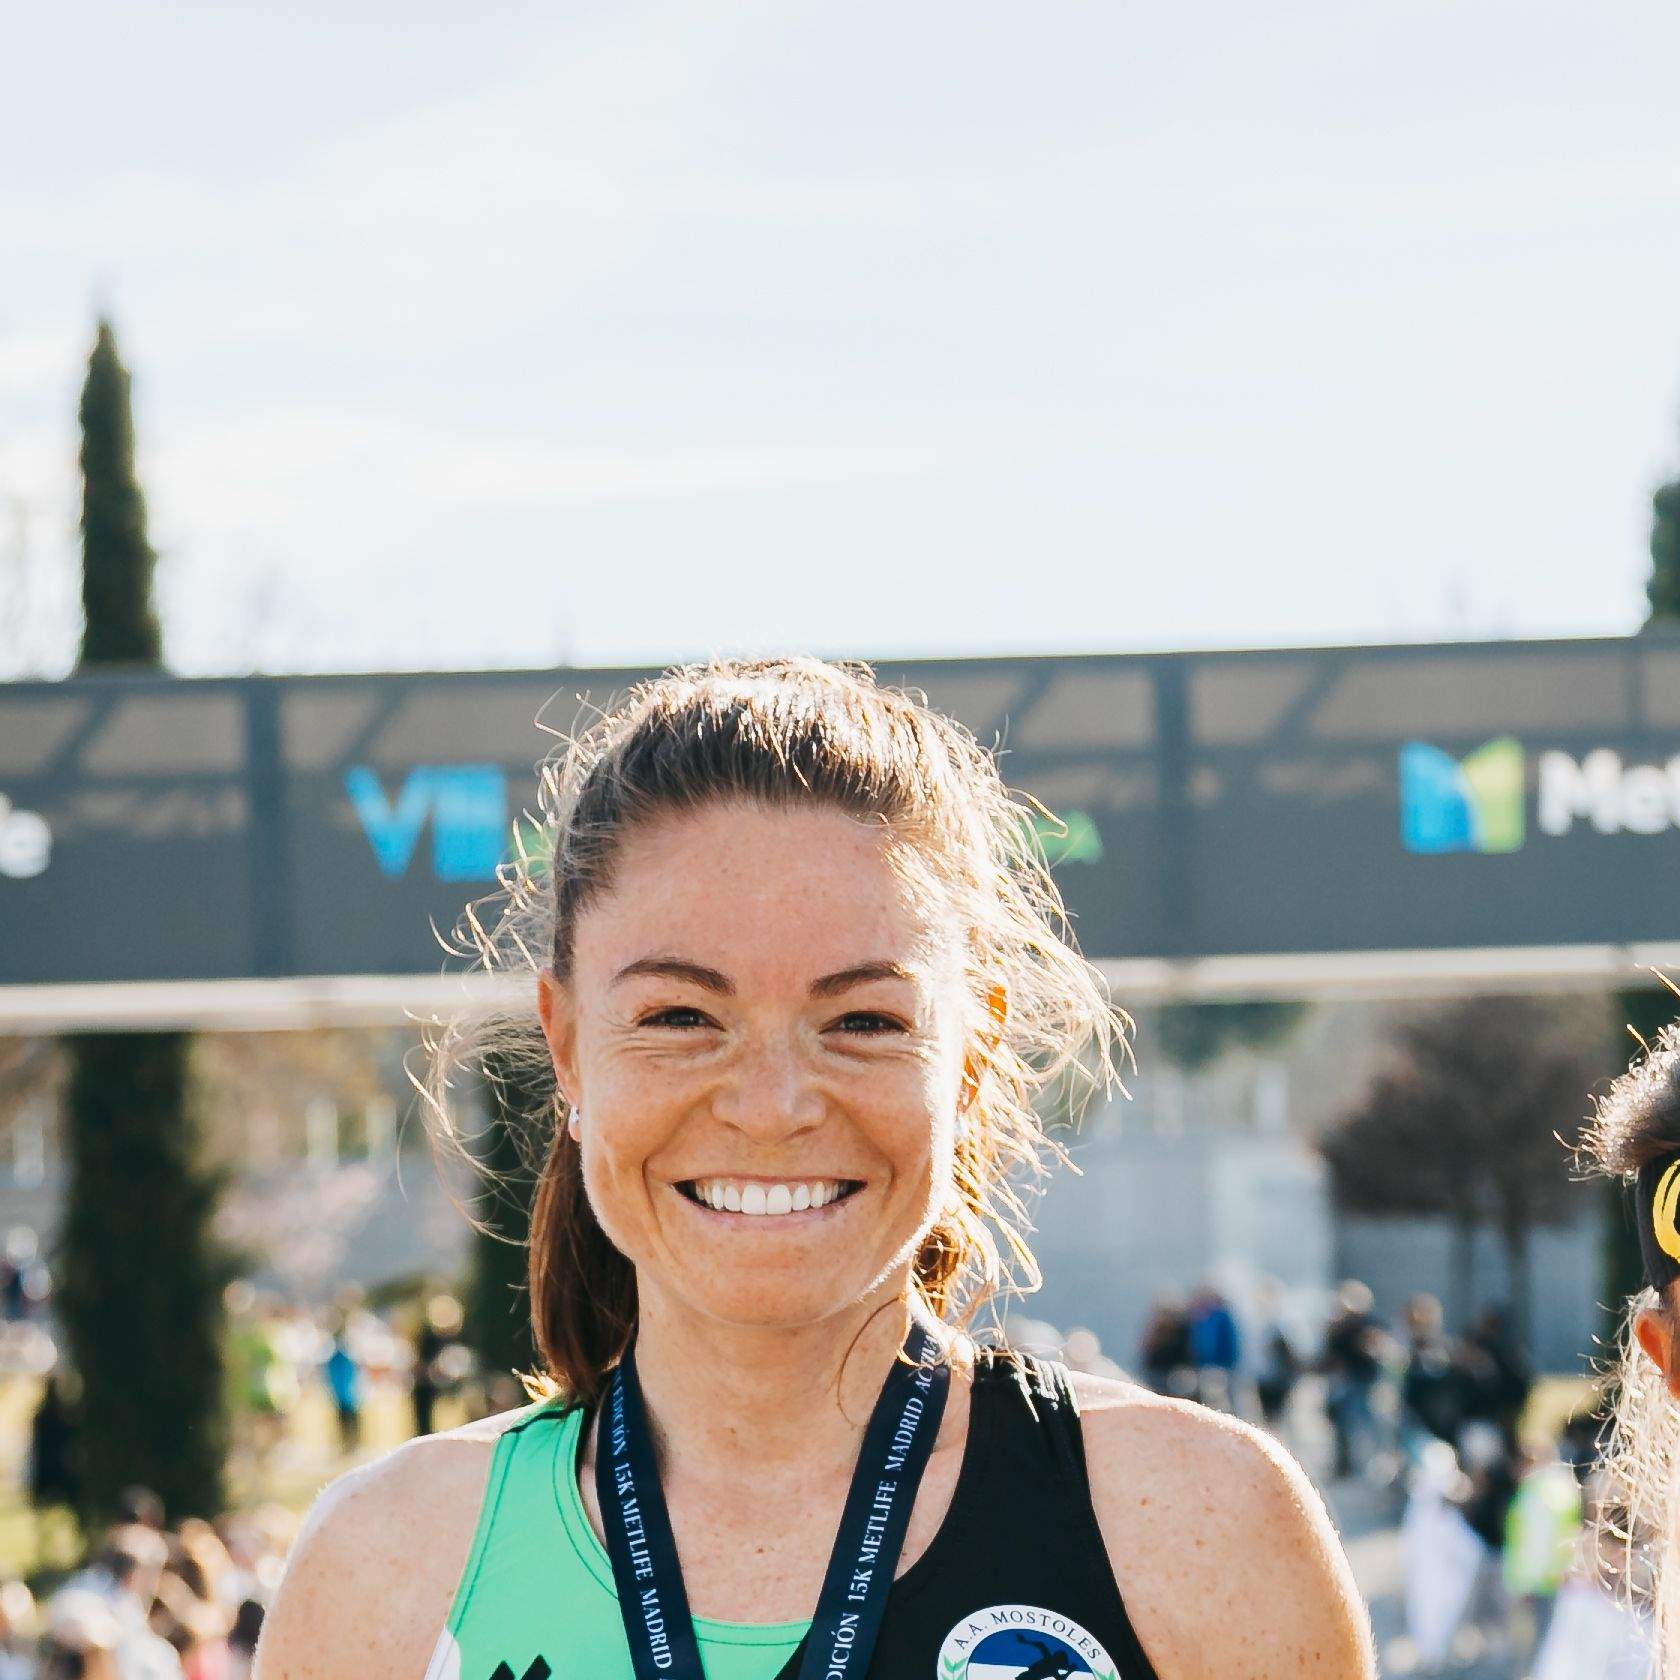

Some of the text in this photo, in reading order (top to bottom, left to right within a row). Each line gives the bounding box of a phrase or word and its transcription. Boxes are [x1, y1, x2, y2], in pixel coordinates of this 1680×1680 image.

[884, 1396, 925, 1473] MADRID
[614, 1462, 637, 1497] 15K
[620, 1497, 655, 1582] METLIFE
[857, 1479, 898, 1565] METLIFE
[847, 1567, 874, 1603] 15K
[639, 1587, 675, 1671] MADRID
[954, 1610, 1102, 1661] A.A. MOSTOLES
